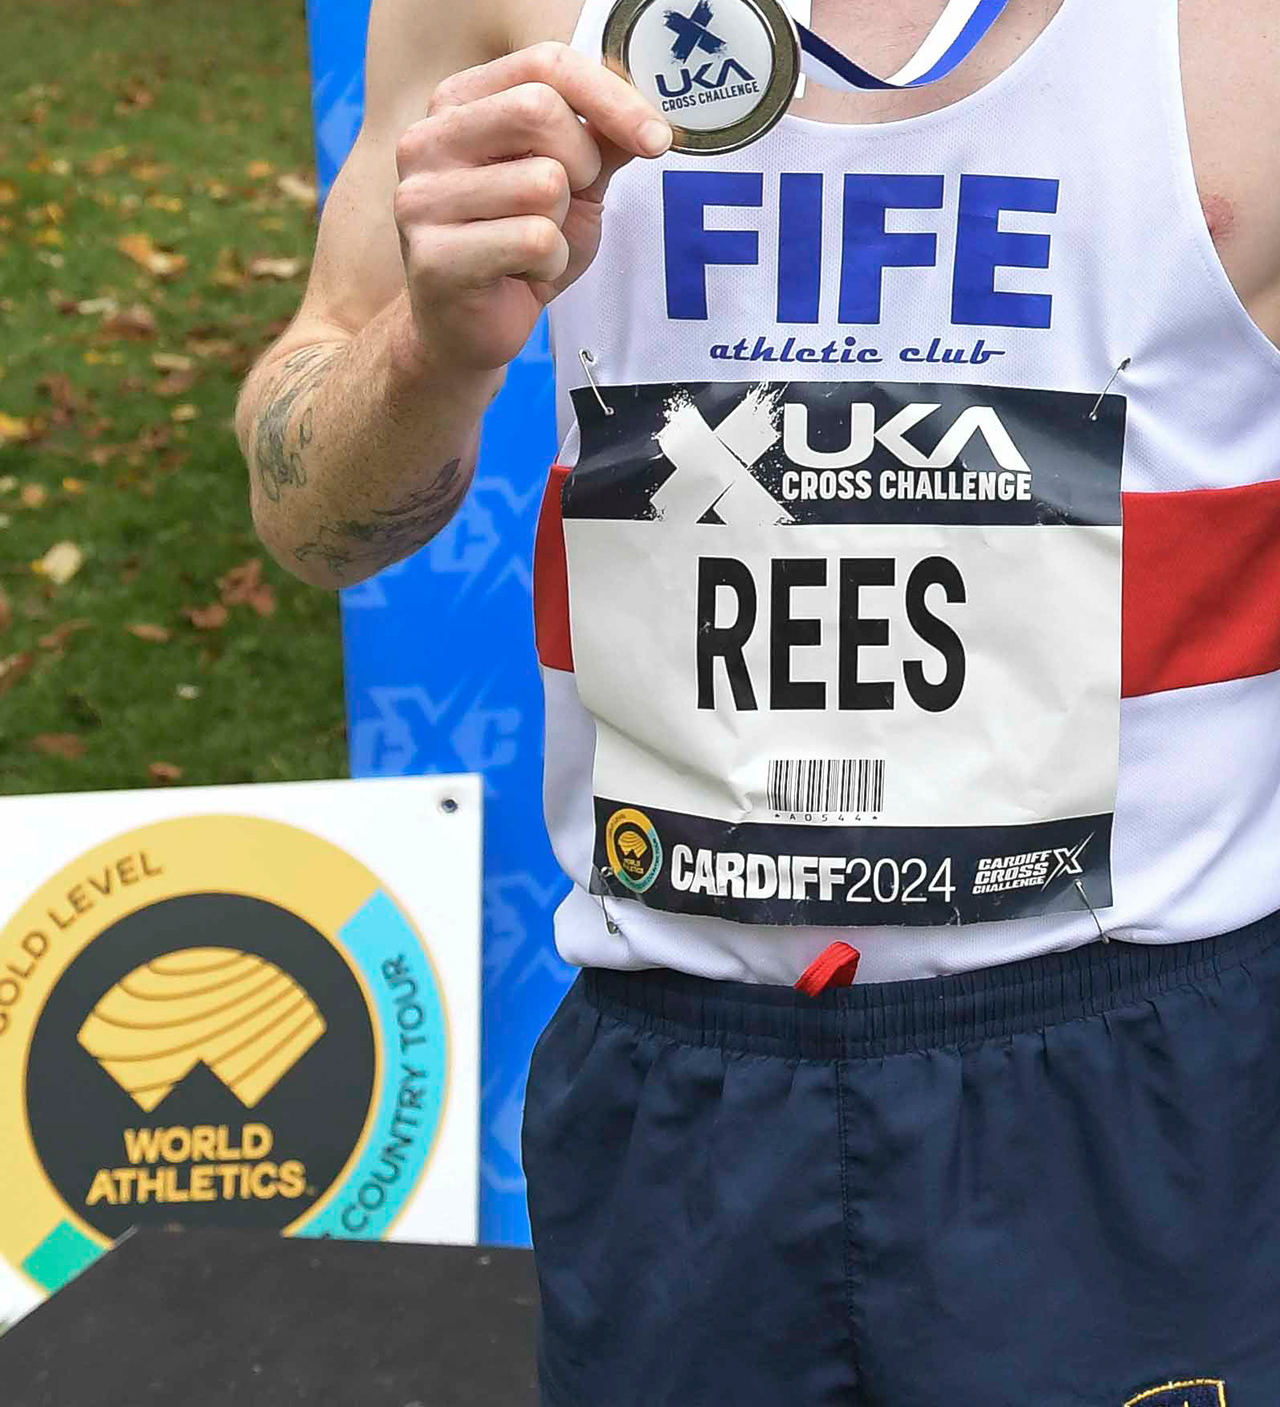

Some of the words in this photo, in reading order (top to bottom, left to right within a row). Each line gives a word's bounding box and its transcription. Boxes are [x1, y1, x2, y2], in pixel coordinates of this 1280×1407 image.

[655, 58, 755, 97] UKA
[662, 95, 696, 112] CROSS
[698, 81, 759, 104] CHALLENGE
[662, 169, 1059, 329] FIFE
[710, 336, 883, 363] athletic
[900, 337, 1006, 364] club
[783, 402, 1031, 472] UKA
[782, 471, 872, 500] CROSS
[879, 471, 1033, 502] CHALLENGE
[697, 555, 967, 713] REES
[975, 862, 1049, 885] CROSS
[978, 850, 1053, 871] CARDIFF
[48, 852, 163, 930] LEVEL
[972, 876, 1046, 894] CHALLENGE
[382, 954, 427, 1054] TOUR
[123, 1123, 273, 1164] WORLD
[342, 1064, 428, 1232] COUNTRY
[85, 1160, 307, 1206] ATHLETICS
